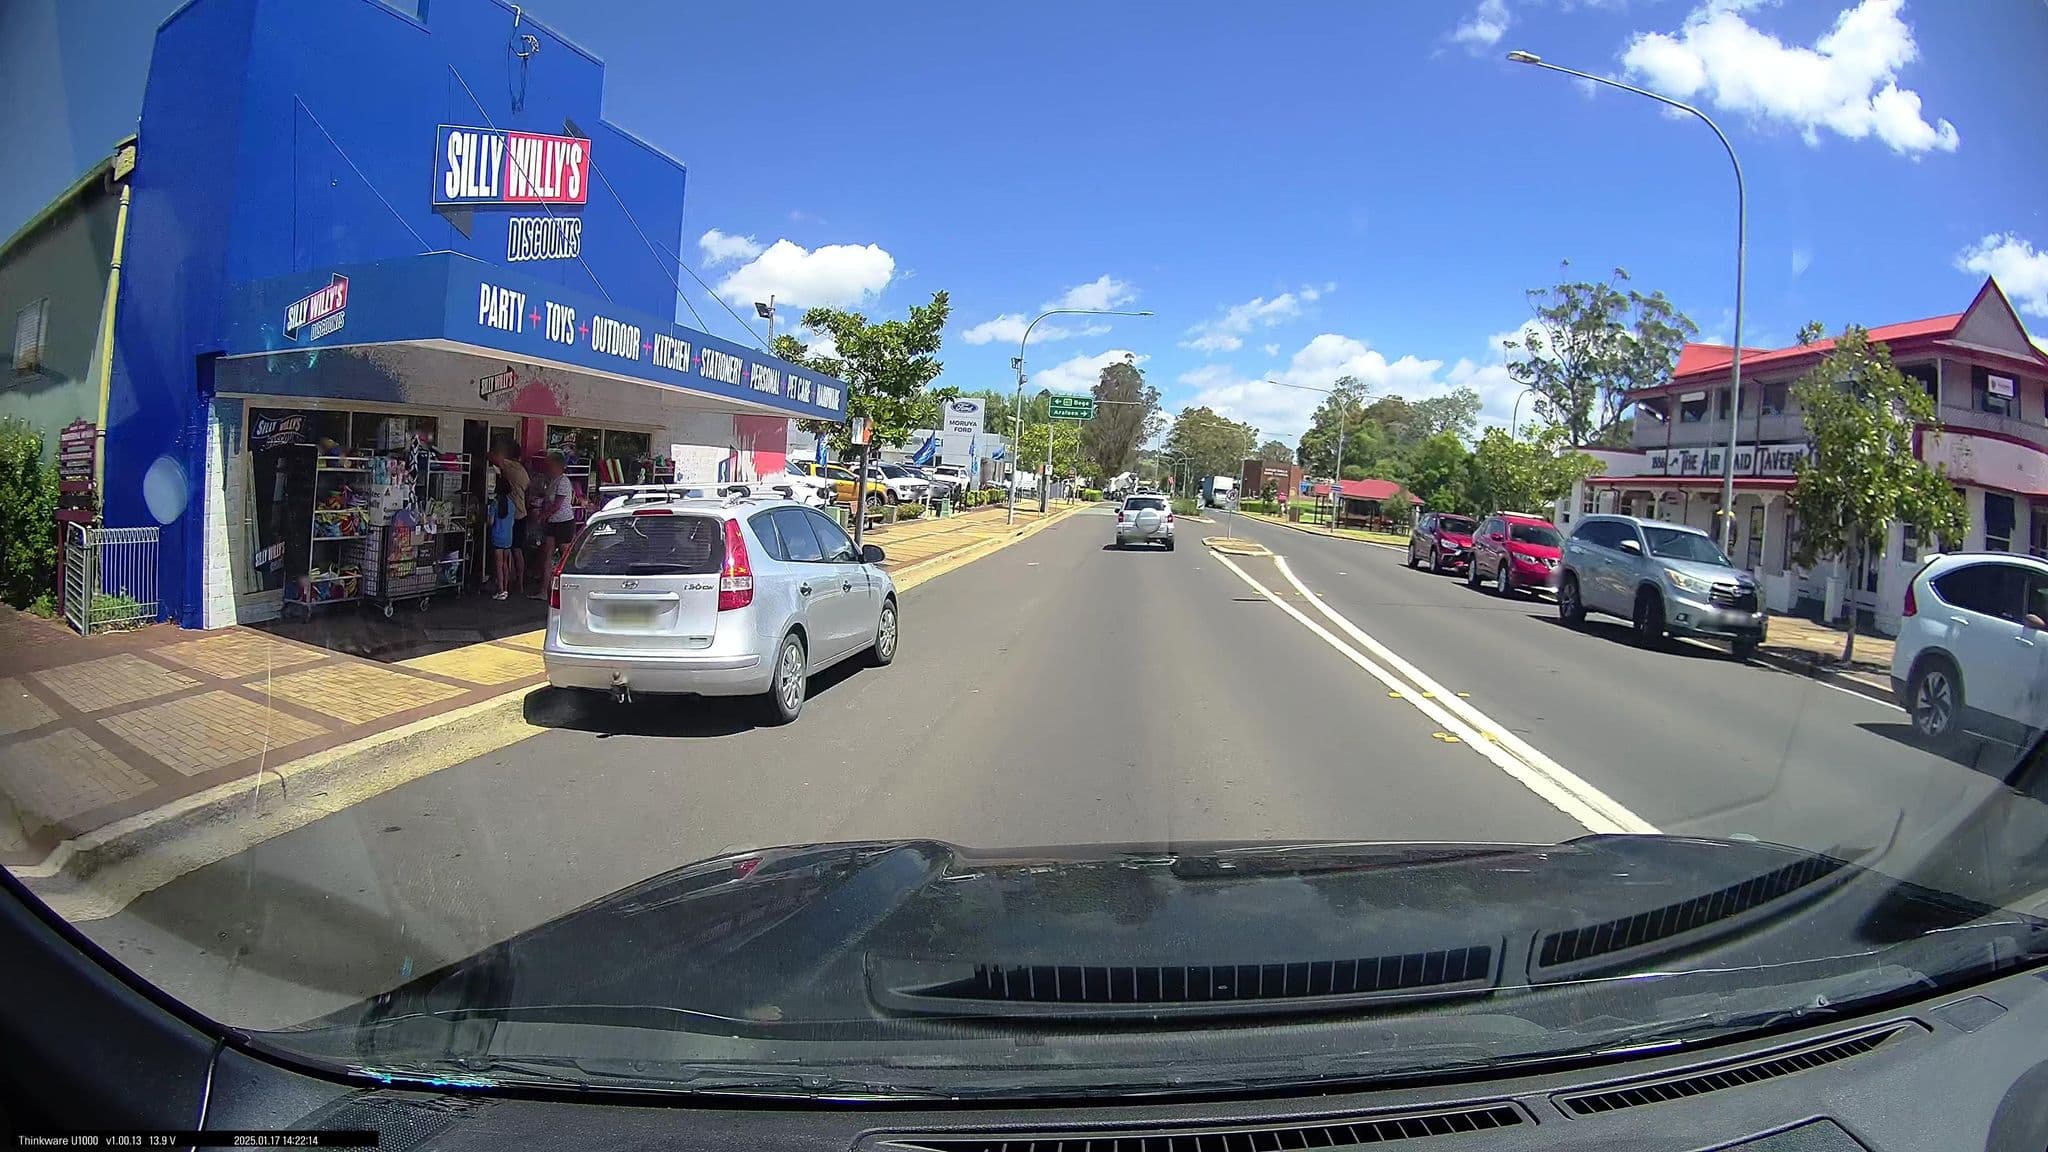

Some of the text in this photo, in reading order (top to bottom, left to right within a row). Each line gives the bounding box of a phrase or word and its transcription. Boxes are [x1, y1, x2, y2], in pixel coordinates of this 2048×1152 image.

[445, 131, 583, 199] SILLY WILLY'S
[507, 216, 582, 262] DISCOUNTS
[287, 283, 343, 332] SILLY WILLY'S
[478, 282, 526, 334] PARTY
[545, 300, 576, 346] TOYS
[591, 315, 641, 361] OUTDOOR
[653, 333, 692, 373] KITCHEN
[700, 347, 744, 387] STATIONERY
[750, 362, 781, 396] PERSONAL
[1679, 450, 1698, 475] THE
[1700, 449, 1720, 475] AIR
[1724, 448, 1752, 475] AID
